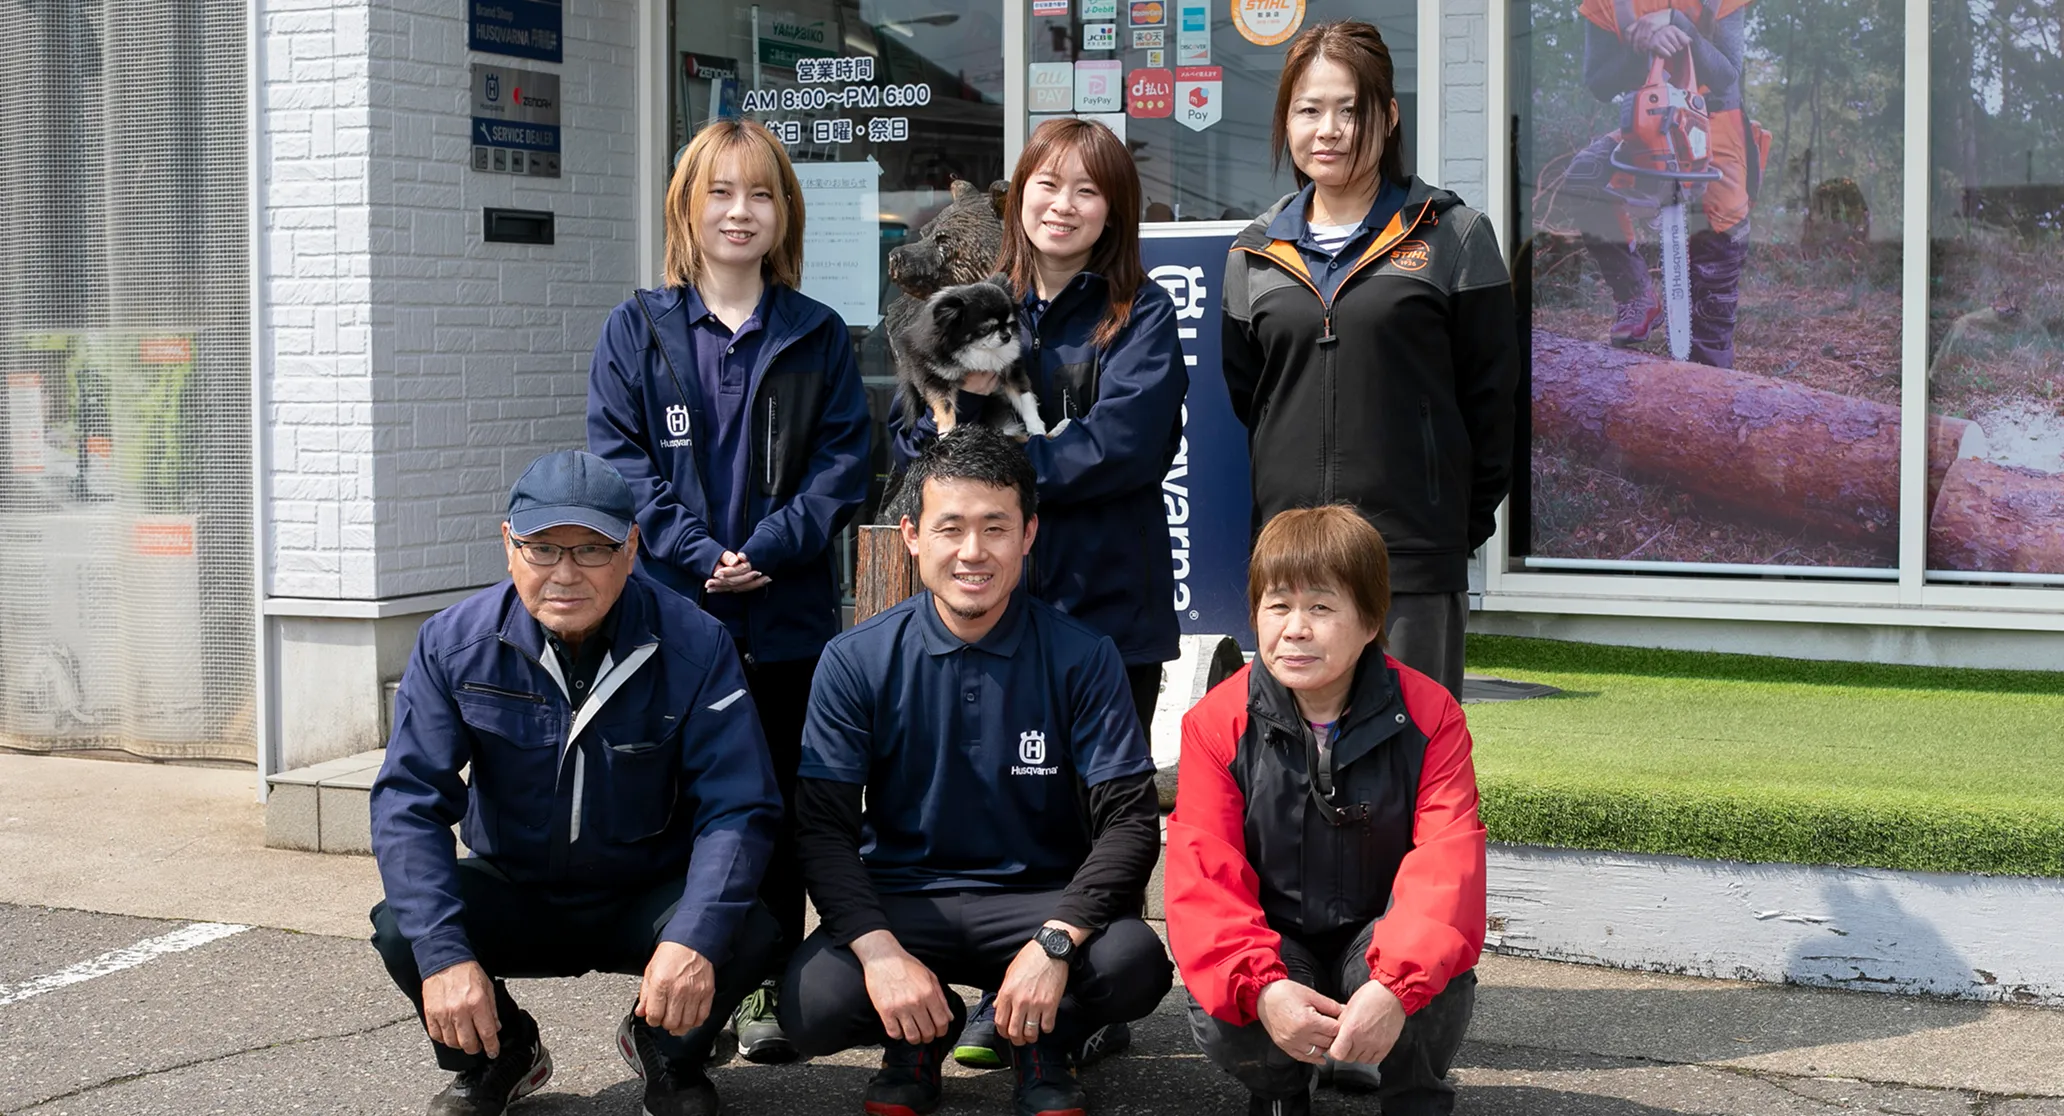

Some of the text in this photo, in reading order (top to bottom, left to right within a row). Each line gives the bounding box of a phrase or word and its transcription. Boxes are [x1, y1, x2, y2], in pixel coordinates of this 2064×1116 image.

[476, 23, 530, 47] HUSQVARNA
[773, 20, 824, 44] YAMABIKO
[796, 57, 875, 83] 営業時間
[1036, 71, 1066, 85] au
[1132, 80, 1169, 96] d払い
[742, 90, 777, 112] AM
[883, 83, 931, 106] 6:00
[1037, 89, 1064, 104] PAY
[1083, 97, 1111, 105] PayPay
[1188, 110, 1208, 121] Pay
[492, 125, 555, 147] SERVICE DEALER
[1391, 250, 1428, 261] STIHL
[1672, 225, 1682, 287] Husqvarna
[1011, 766, 1058, 775] Husqvarna
